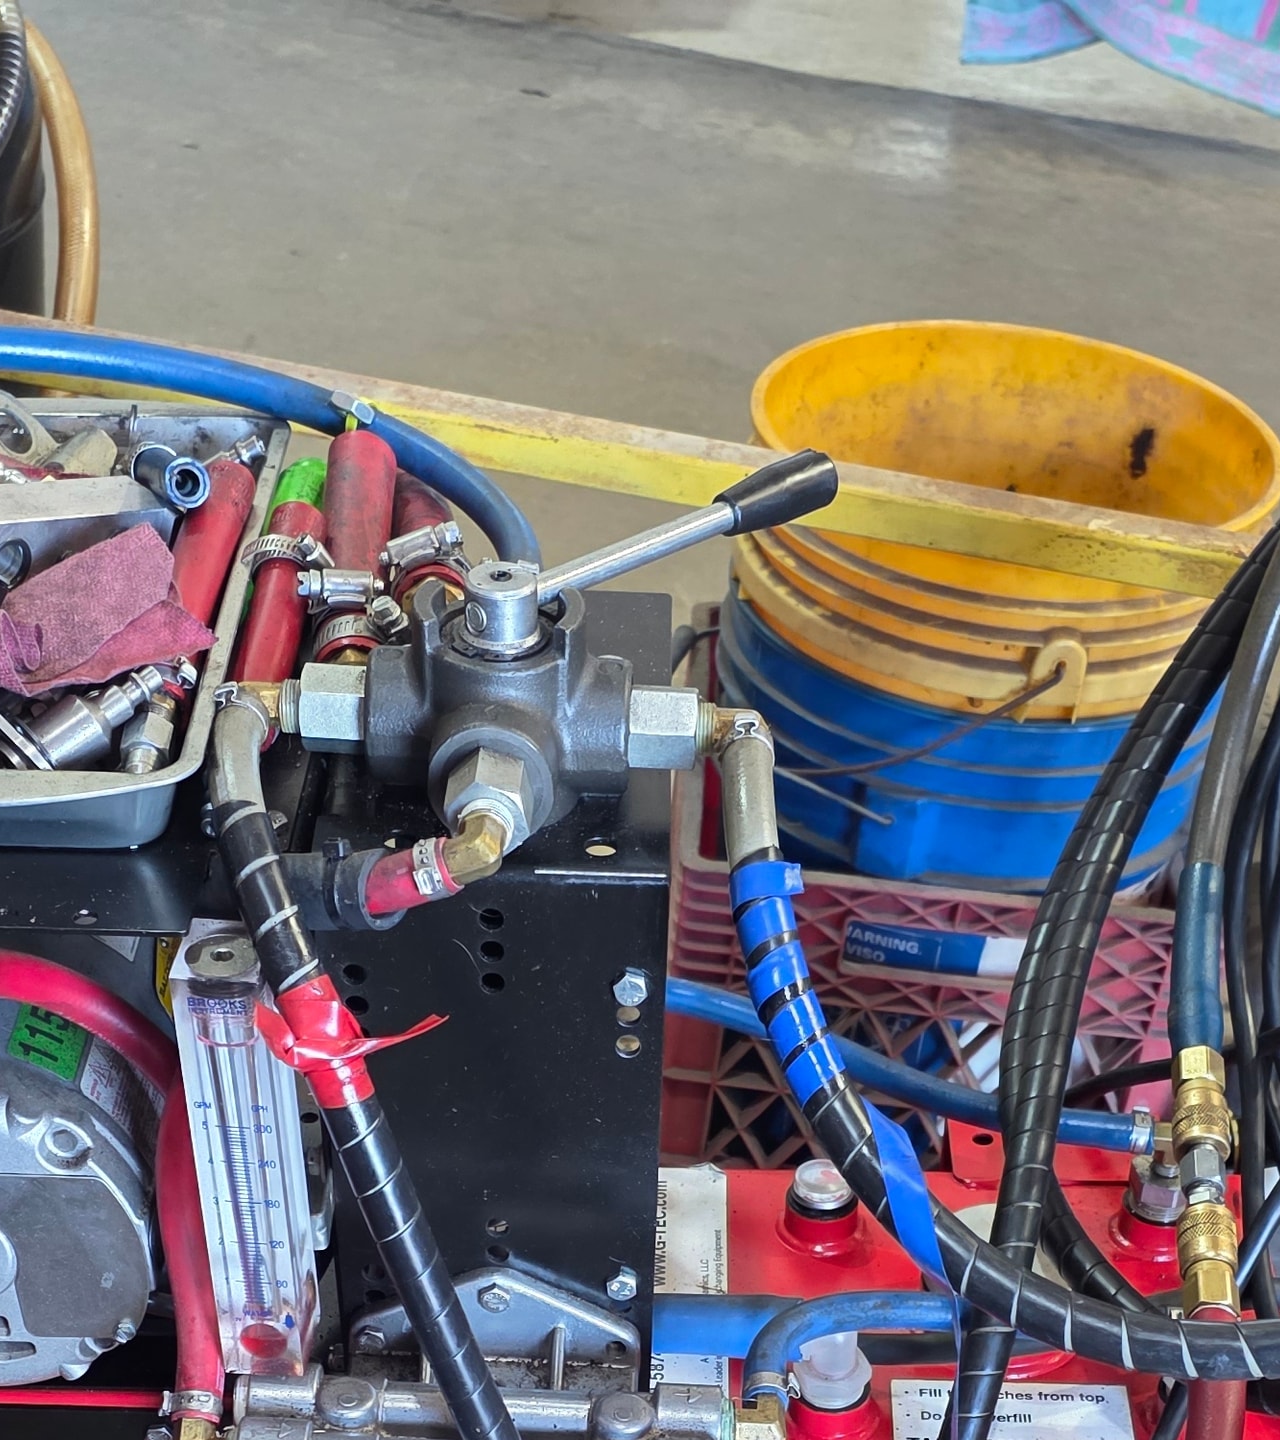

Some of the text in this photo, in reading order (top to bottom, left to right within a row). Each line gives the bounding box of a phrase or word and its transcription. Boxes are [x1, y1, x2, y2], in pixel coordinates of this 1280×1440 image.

[186, 997, 247, 1010] BROOKS
[193, 1101, 269, 1113] GPM GPH
[201, 1121, 273, 1134] 5 300
[213, 1196, 281, 1209] 3 180
[653, 1180, 668, 1288] www.G-TEC.com
[270, 1240, 285, 1249] 120
[713, 1229, 724, 1262] Equipment
[700, 1259, 709, 1273] LLC
[275, 1280, 289, 1289] 60
[918, 1388, 943, 1398] Fill
[997, 1390, 1033, 1402] ches
[1038, 1391, 1075, 1402] from
[1079, 1392, 1110, 1405] top.
[920, 1410, 1032, 1424] Do verfill
